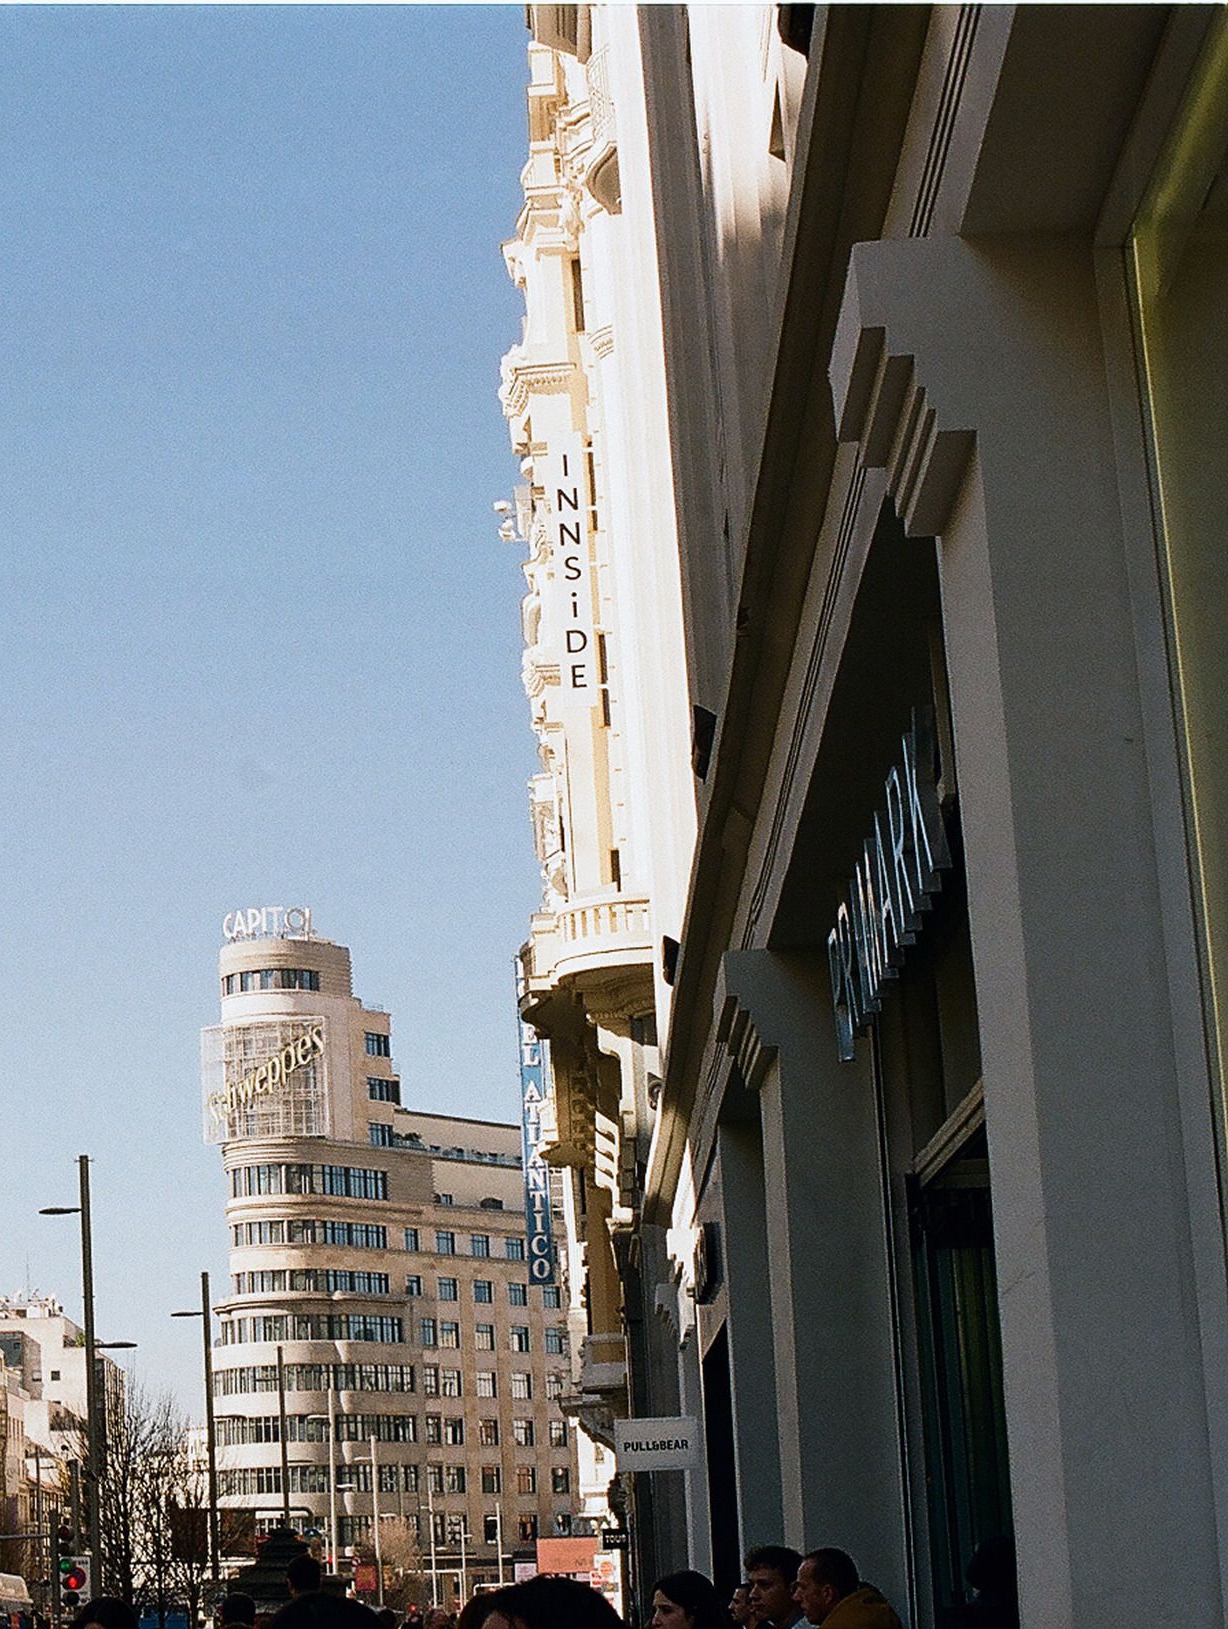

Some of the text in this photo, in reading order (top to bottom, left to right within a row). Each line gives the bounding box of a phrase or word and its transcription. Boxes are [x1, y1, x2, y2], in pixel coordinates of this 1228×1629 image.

[557, 454, 587, 688] INNSiDE
[223, 907, 316, 939] CAPITOL
[208, 1022, 323, 1126] Schweppes
[624, 1439, 689, 1452] PULL&BEAR
